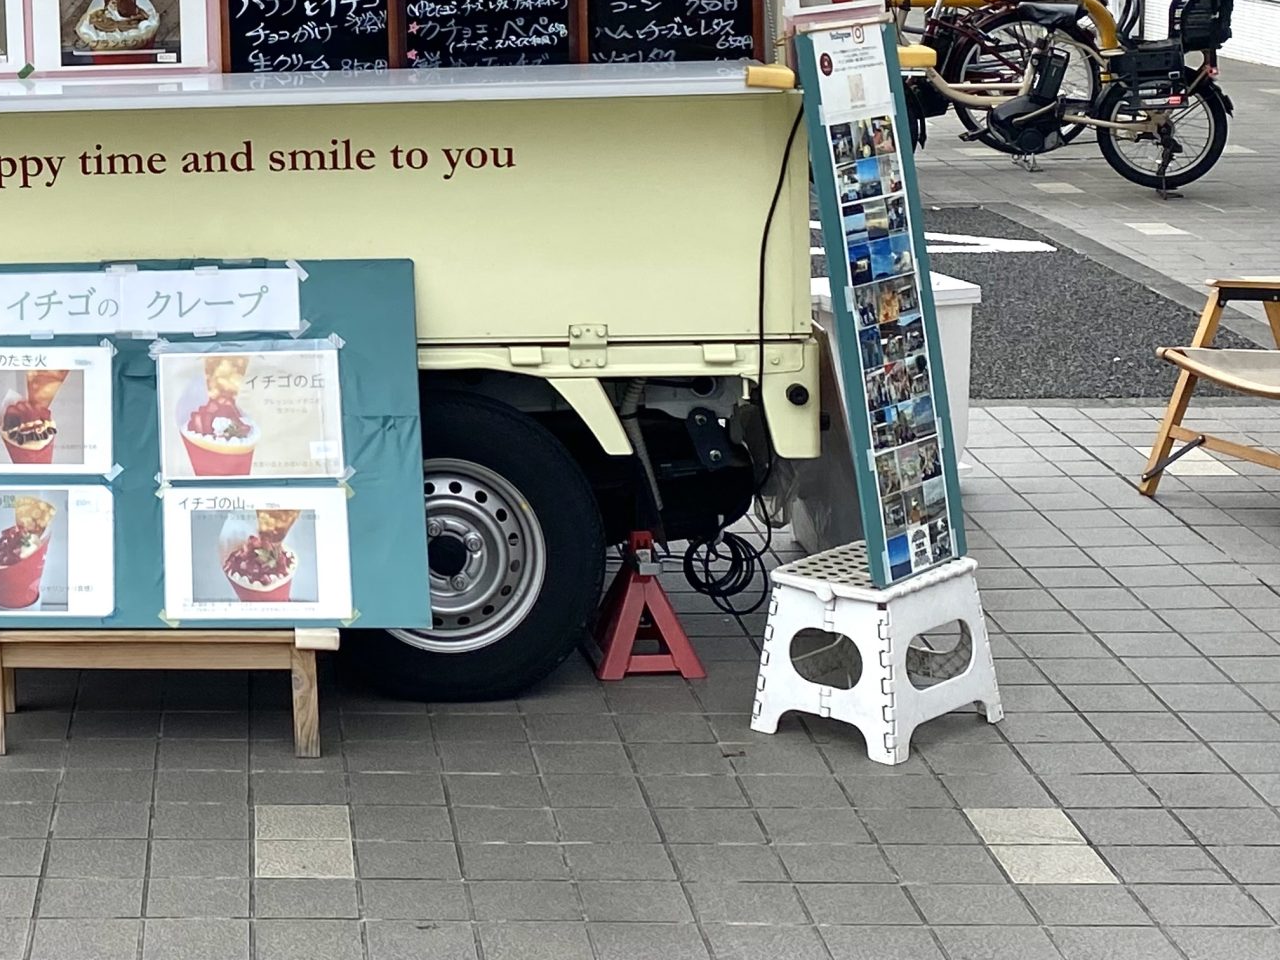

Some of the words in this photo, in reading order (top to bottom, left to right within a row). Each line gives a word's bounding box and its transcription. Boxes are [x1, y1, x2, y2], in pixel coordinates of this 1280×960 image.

[609, 0, 662, 13] コーン
[245, 21, 339, 47] チョコがけ
[78, 143, 167, 176] time
[181, 141, 255, 174] and
[268, 137, 377, 171] smile
[391, 146, 428, 170] to
[441, 146, 517, 180] you
[6, 286, 120, 321] イチゴの
[145, 284, 269, 321] クレープ
[245, 373, 326, 390] イチゴの丘
[178, 496, 245, 511] イチゴの山
